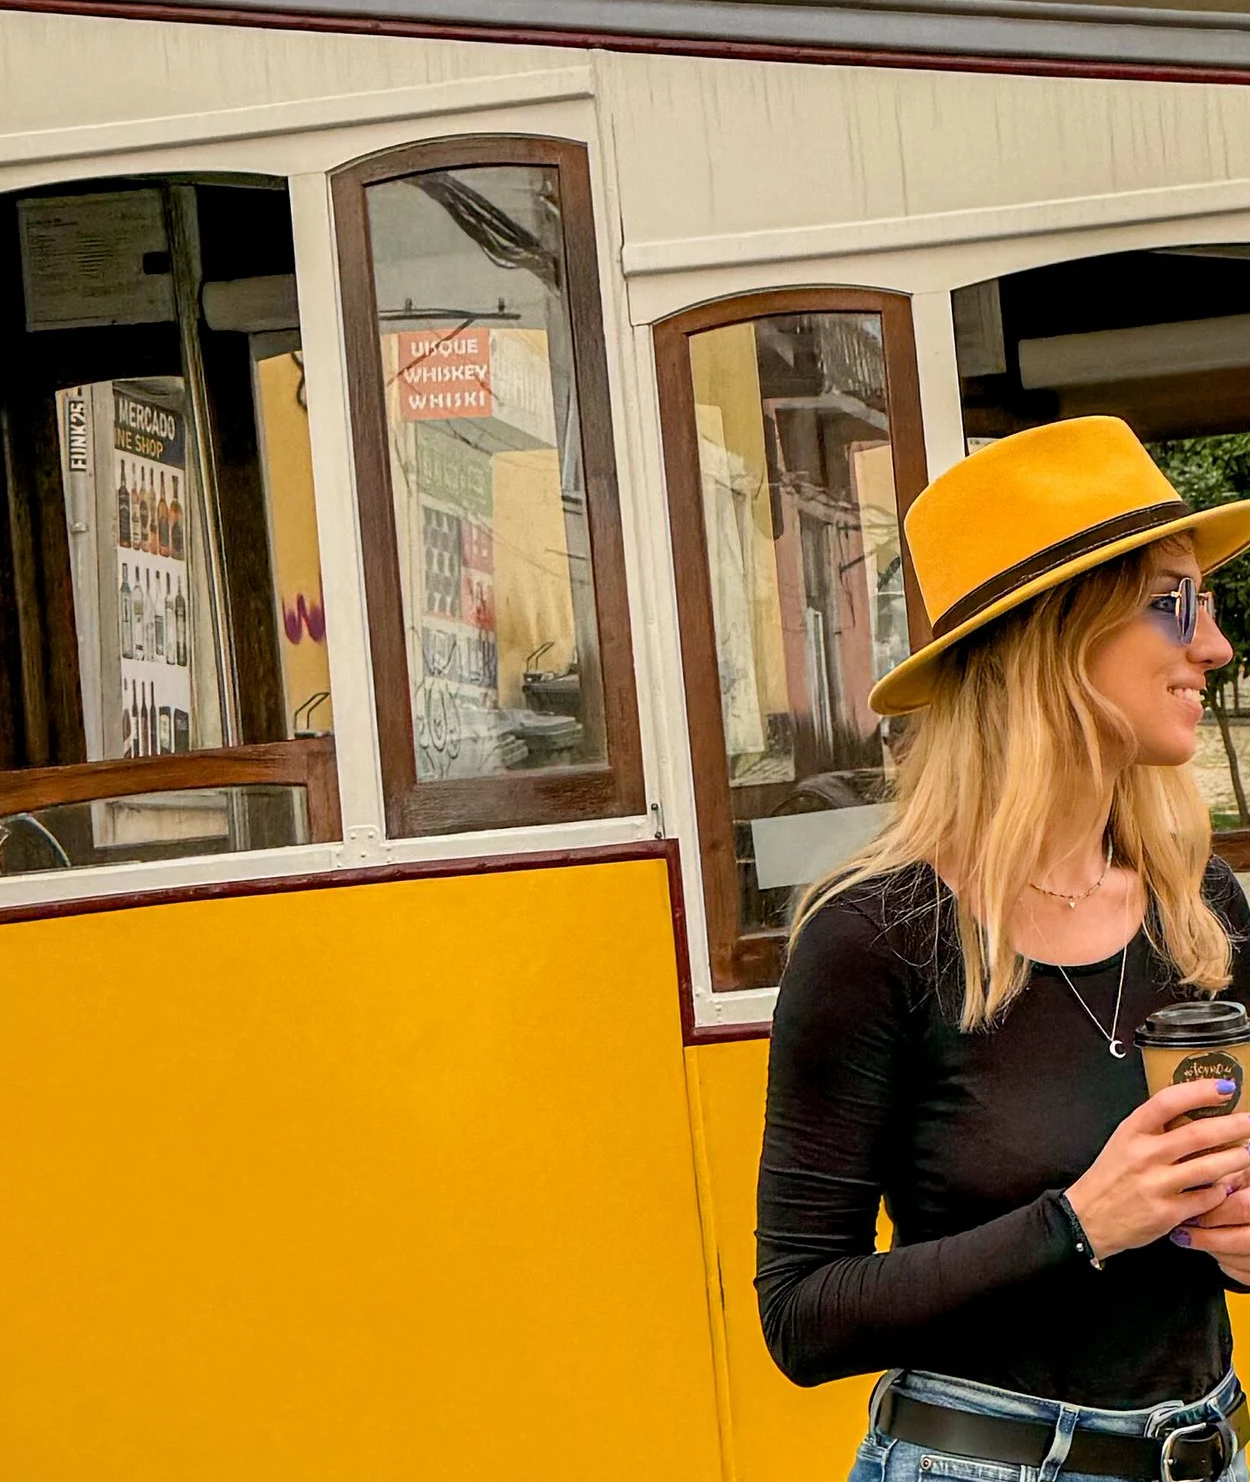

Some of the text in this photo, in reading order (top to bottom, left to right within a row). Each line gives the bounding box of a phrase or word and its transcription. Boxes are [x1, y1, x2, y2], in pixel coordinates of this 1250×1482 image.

[404, 364, 488, 384] WHISKEY
[408, 391, 485, 410] WHISKI
[119, 398, 175, 441] MERCADO
[134, 434, 164, 458] SHOP
